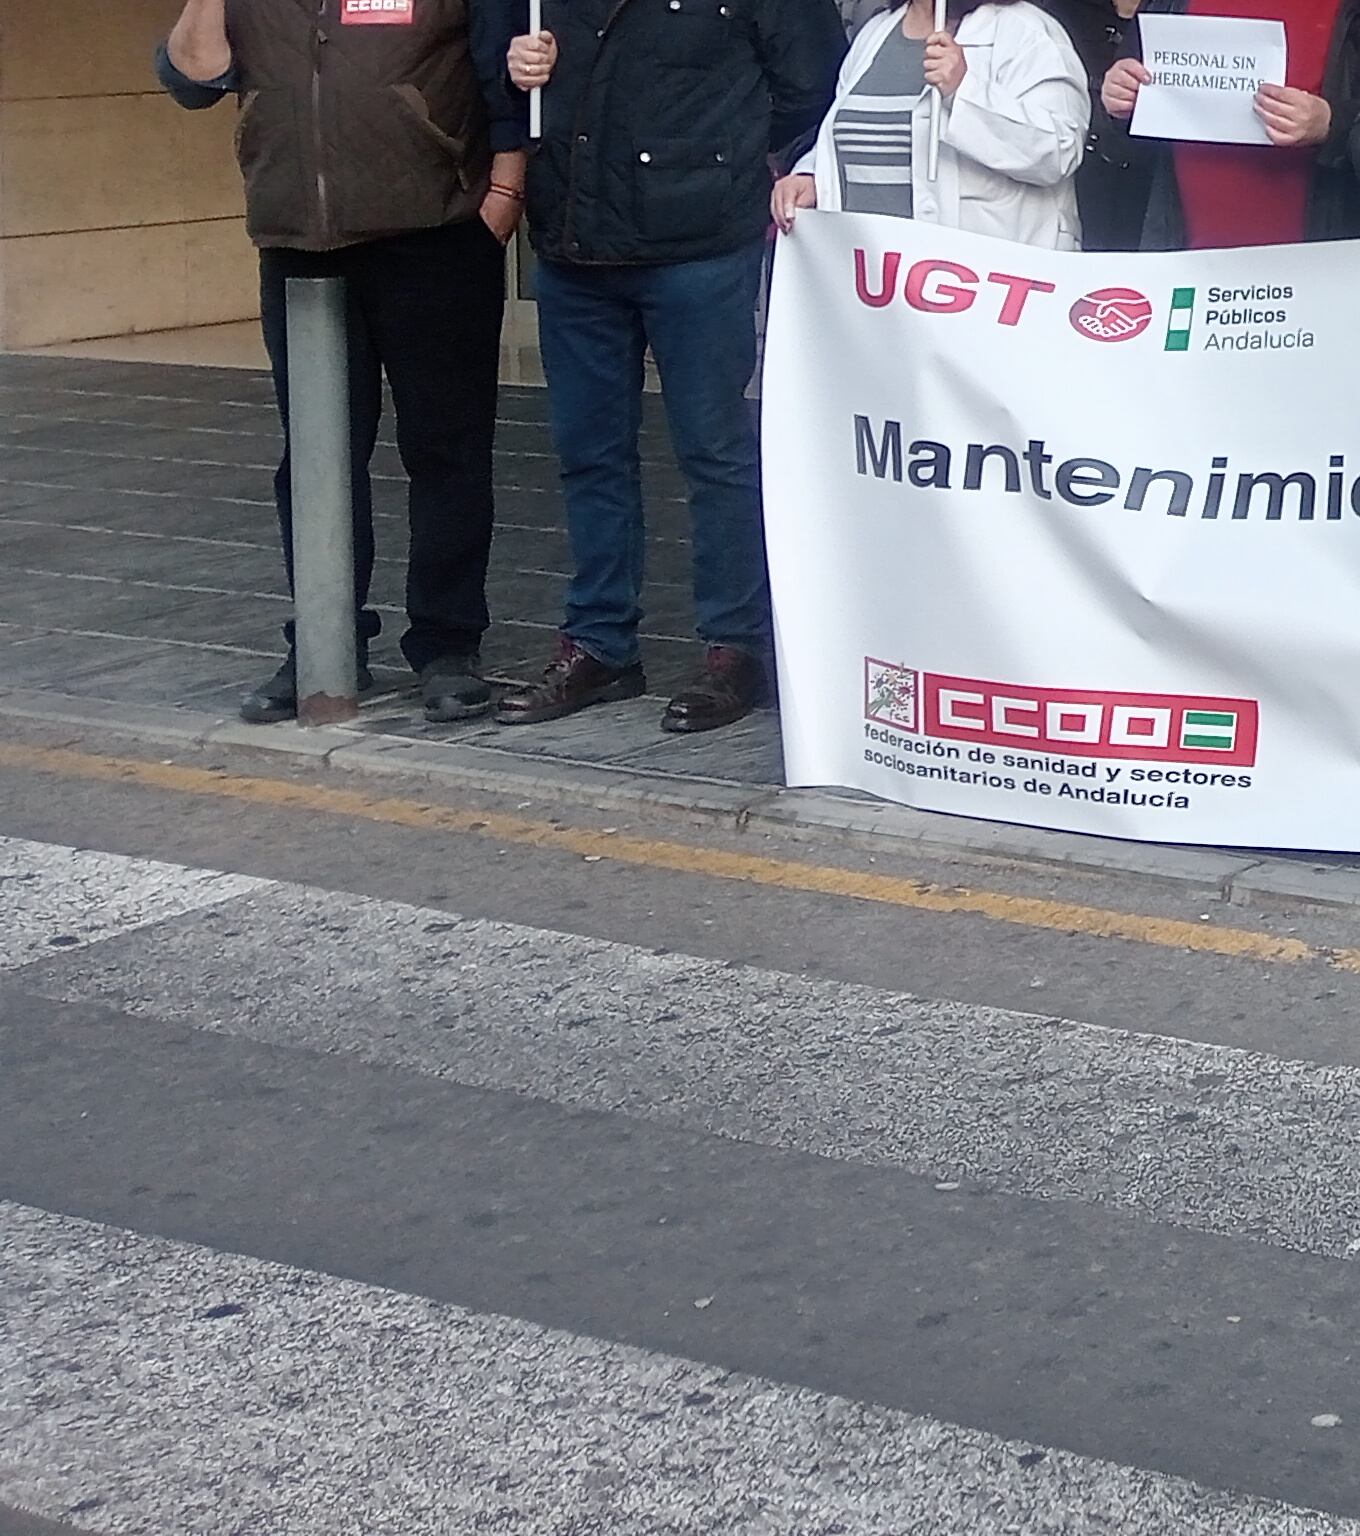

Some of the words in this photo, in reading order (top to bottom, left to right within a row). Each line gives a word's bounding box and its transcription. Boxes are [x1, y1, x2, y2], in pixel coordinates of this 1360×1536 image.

[1153, 50, 1229, 71] PERSONAL
[1232, 54, 1257, 71] SIN
[854, 248, 1056, 327] UGT
[1207, 284, 1294, 303] Servicios
[1205, 307, 1286, 326] Públicos
[1204, 327, 1315, 352] Andalucía
[937, 687, 1174, 749] CCOO
[864, 722, 961, 760] federación
[967, 747, 996, 766] de
[1002, 754, 1098, 779] sanidad
[1106, 765, 1121, 782] y
[1130, 766, 1252, 789] sectores
[864, 748, 1016, 791] sociosanitarios
[1023, 777, 1052, 796] de
[1058, 783, 1190, 810] Andalucía
